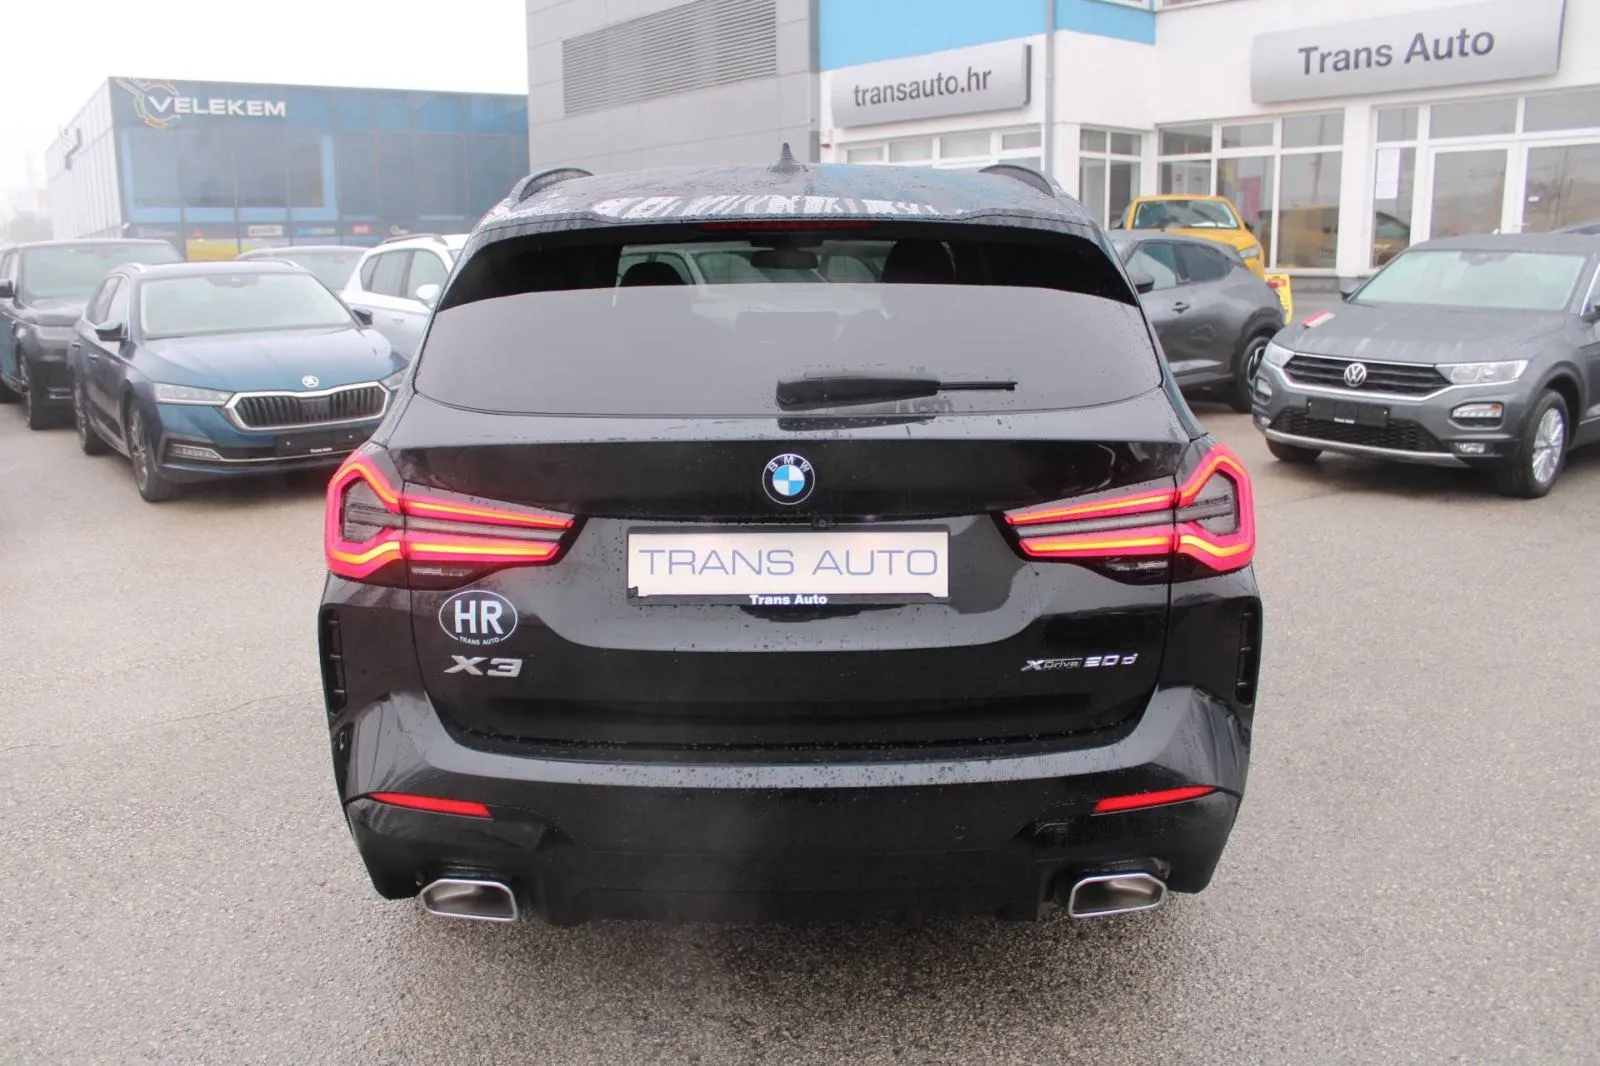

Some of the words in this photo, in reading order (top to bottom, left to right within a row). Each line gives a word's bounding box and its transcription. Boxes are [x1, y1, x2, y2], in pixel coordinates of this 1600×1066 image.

[1298, 44, 1393, 75] Trans
[1404, 28, 1495, 64] Auto
[854, 66, 992, 107] transauto.hr
[147, 95, 286, 117] VELEKEM
[767, 455, 811, 473] BMW
[638, 549, 795, 576] TRANS
[812, 549, 938, 576] AUTO
[749, 594, 791, 605] Trans
[794, 594, 828, 605] Auto
[454, 599, 504, 635] HR
[459, 635, 481, 646] TRANS
[482, 636, 500, 646] AUTO
[443, 654, 523, 678] X3
